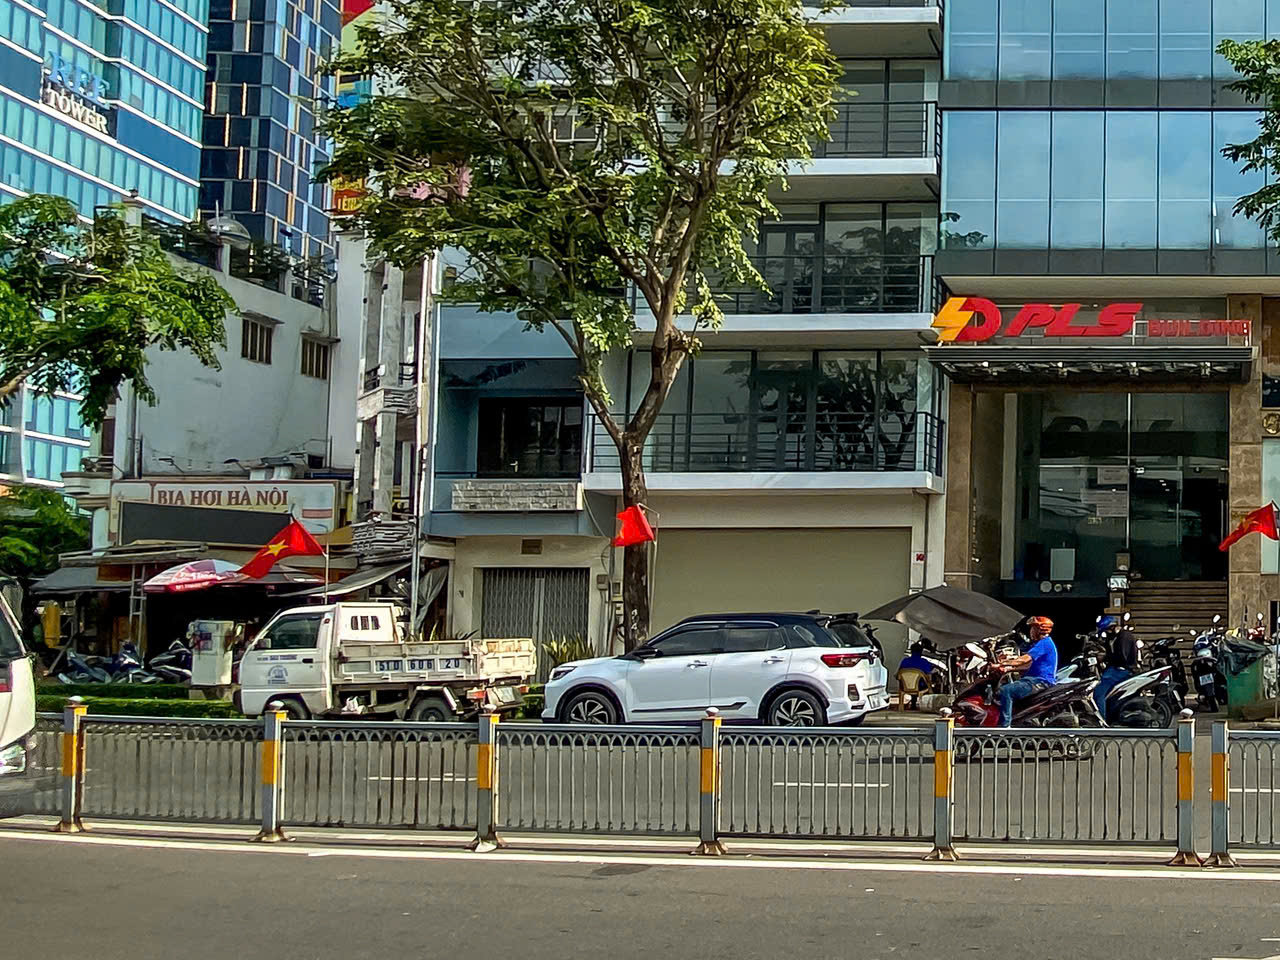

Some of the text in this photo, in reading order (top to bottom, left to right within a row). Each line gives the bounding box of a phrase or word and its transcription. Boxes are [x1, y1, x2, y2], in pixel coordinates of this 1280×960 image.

[47, 87, 109, 134] TOWER
[1148, 320, 1250, 337] BUILDING
[157, 486, 289, 510] BIA HƠI HÀ NỘI
[410, 659, 433, 670] 606
[445, 658, 460, 669] 20
